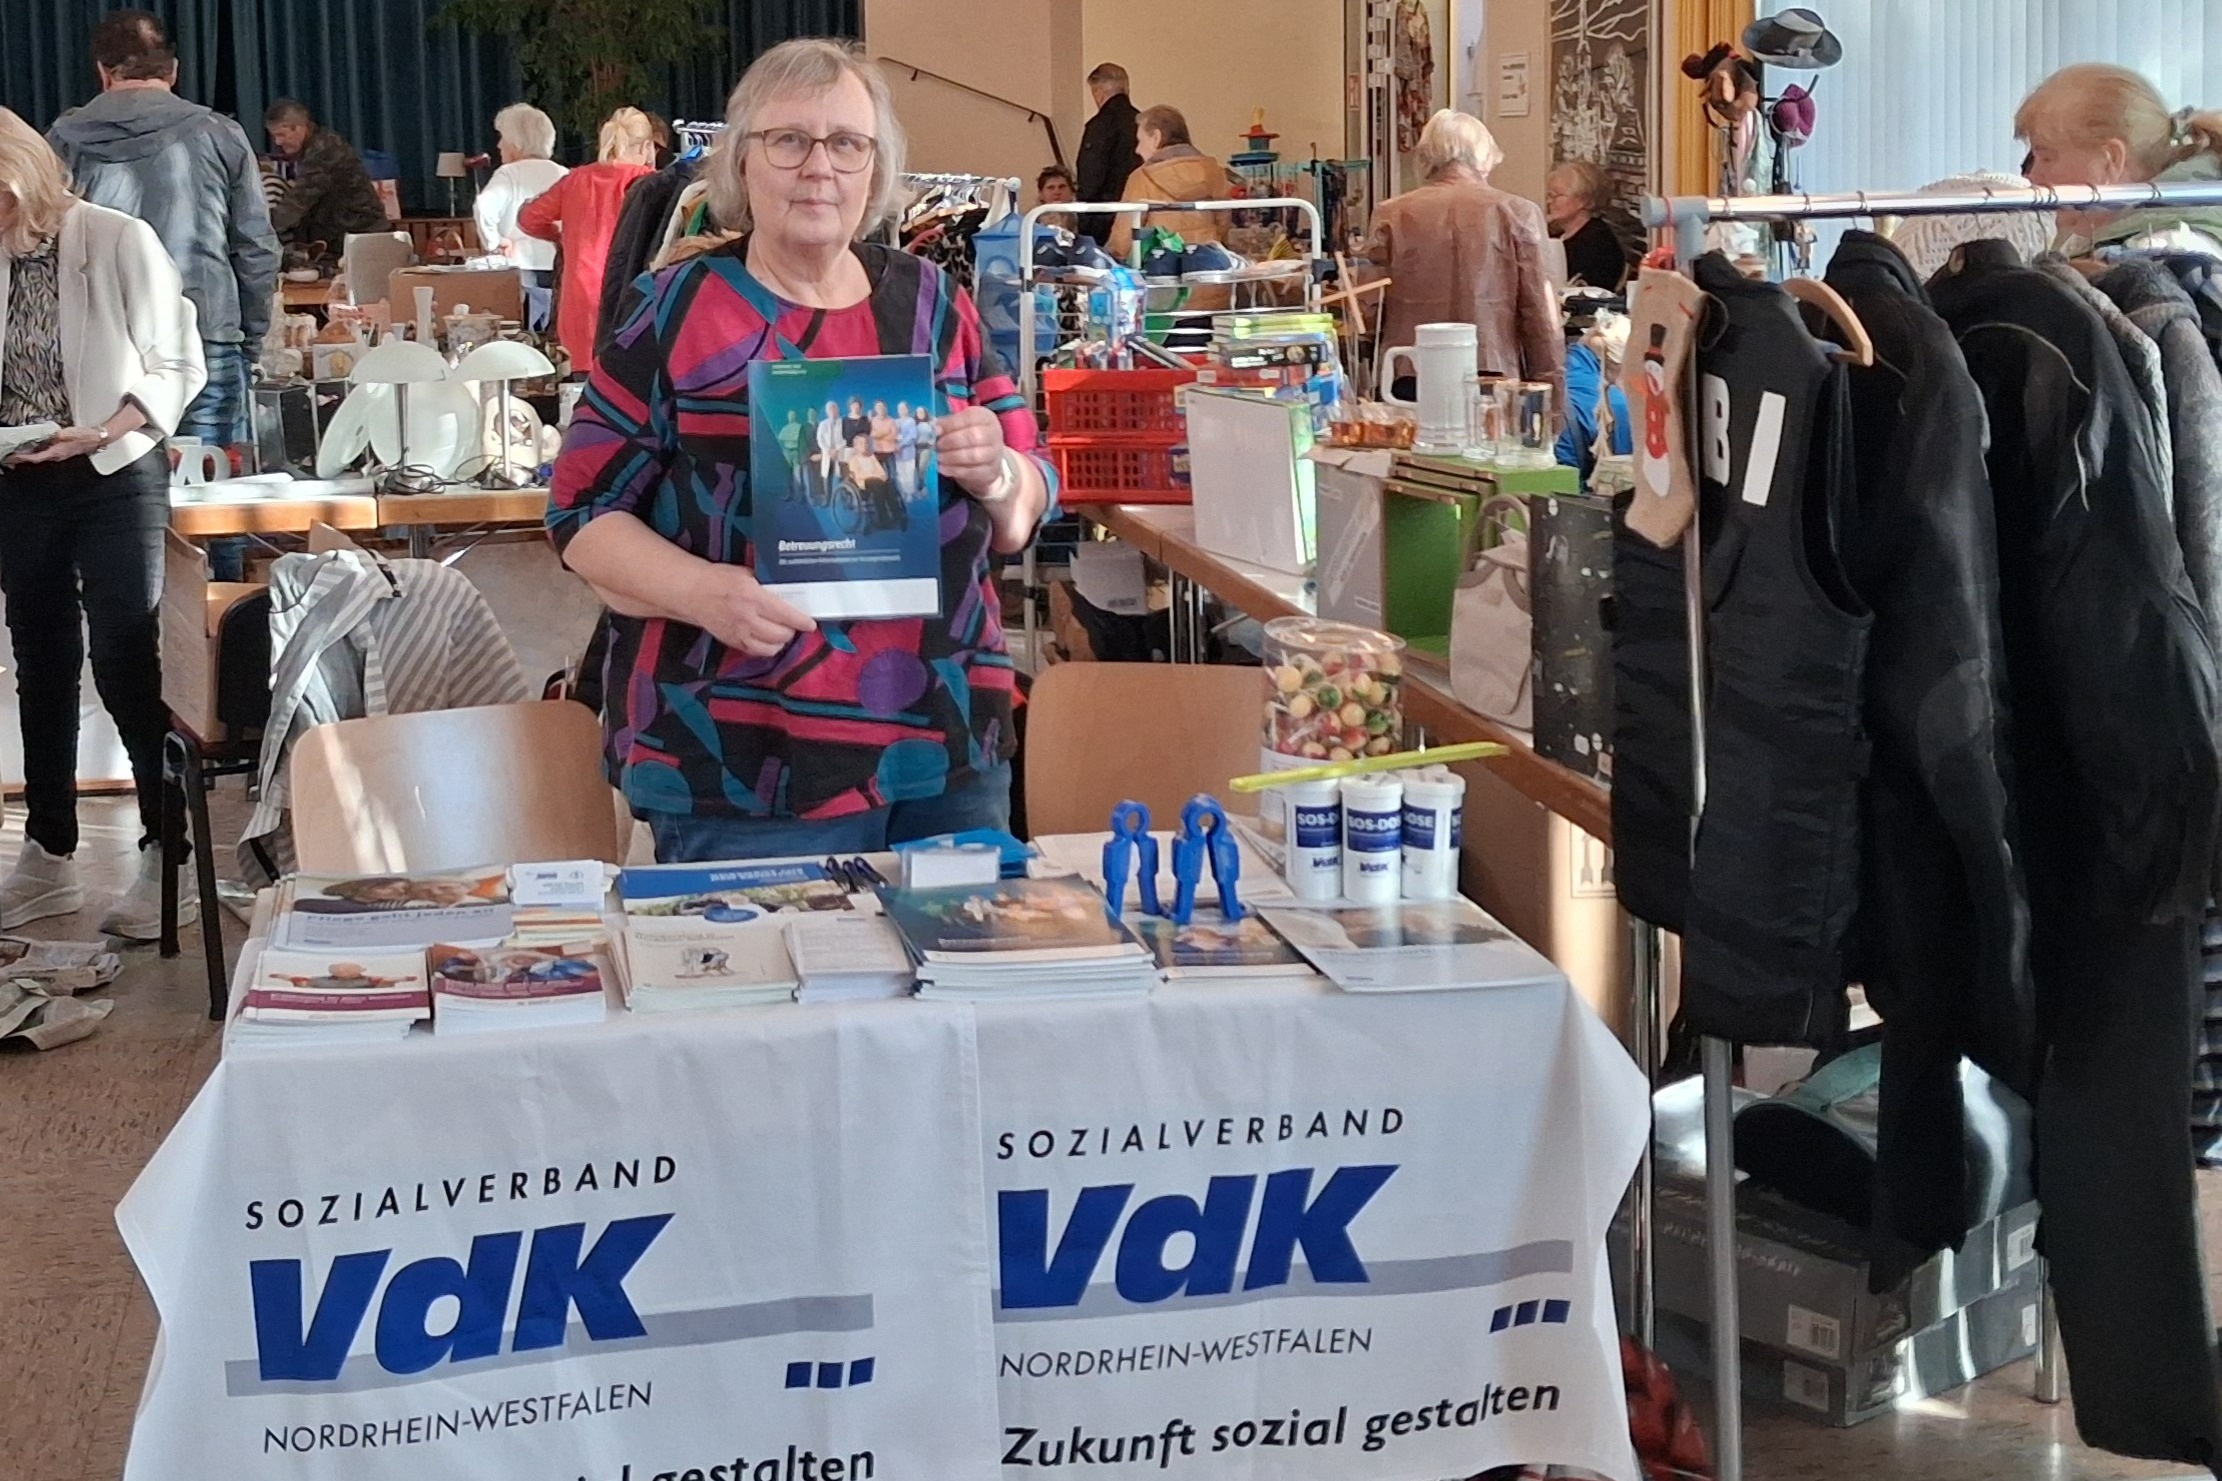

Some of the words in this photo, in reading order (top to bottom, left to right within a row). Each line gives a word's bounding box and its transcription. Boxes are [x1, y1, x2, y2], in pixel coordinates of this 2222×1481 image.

[996, 1107, 1404, 1161] SOZIALVERBAND
[244, 1154, 677, 1231] SOZIALVERBAND
[997, 1163, 1401, 1311] VdK
[249, 1212, 676, 1383] VdK
[999, 1326, 1373, 1379] NORDRHEIN-WESTFALEN
[264, 1380, 653, 1455] NORDRHEIN-WESTFALEN
[1000, 1417, 1197, 1470] Zukunft
[1211, 1405, 1348, 1453] sozial
[1361, 1382, 1561, 1453] gestalten
